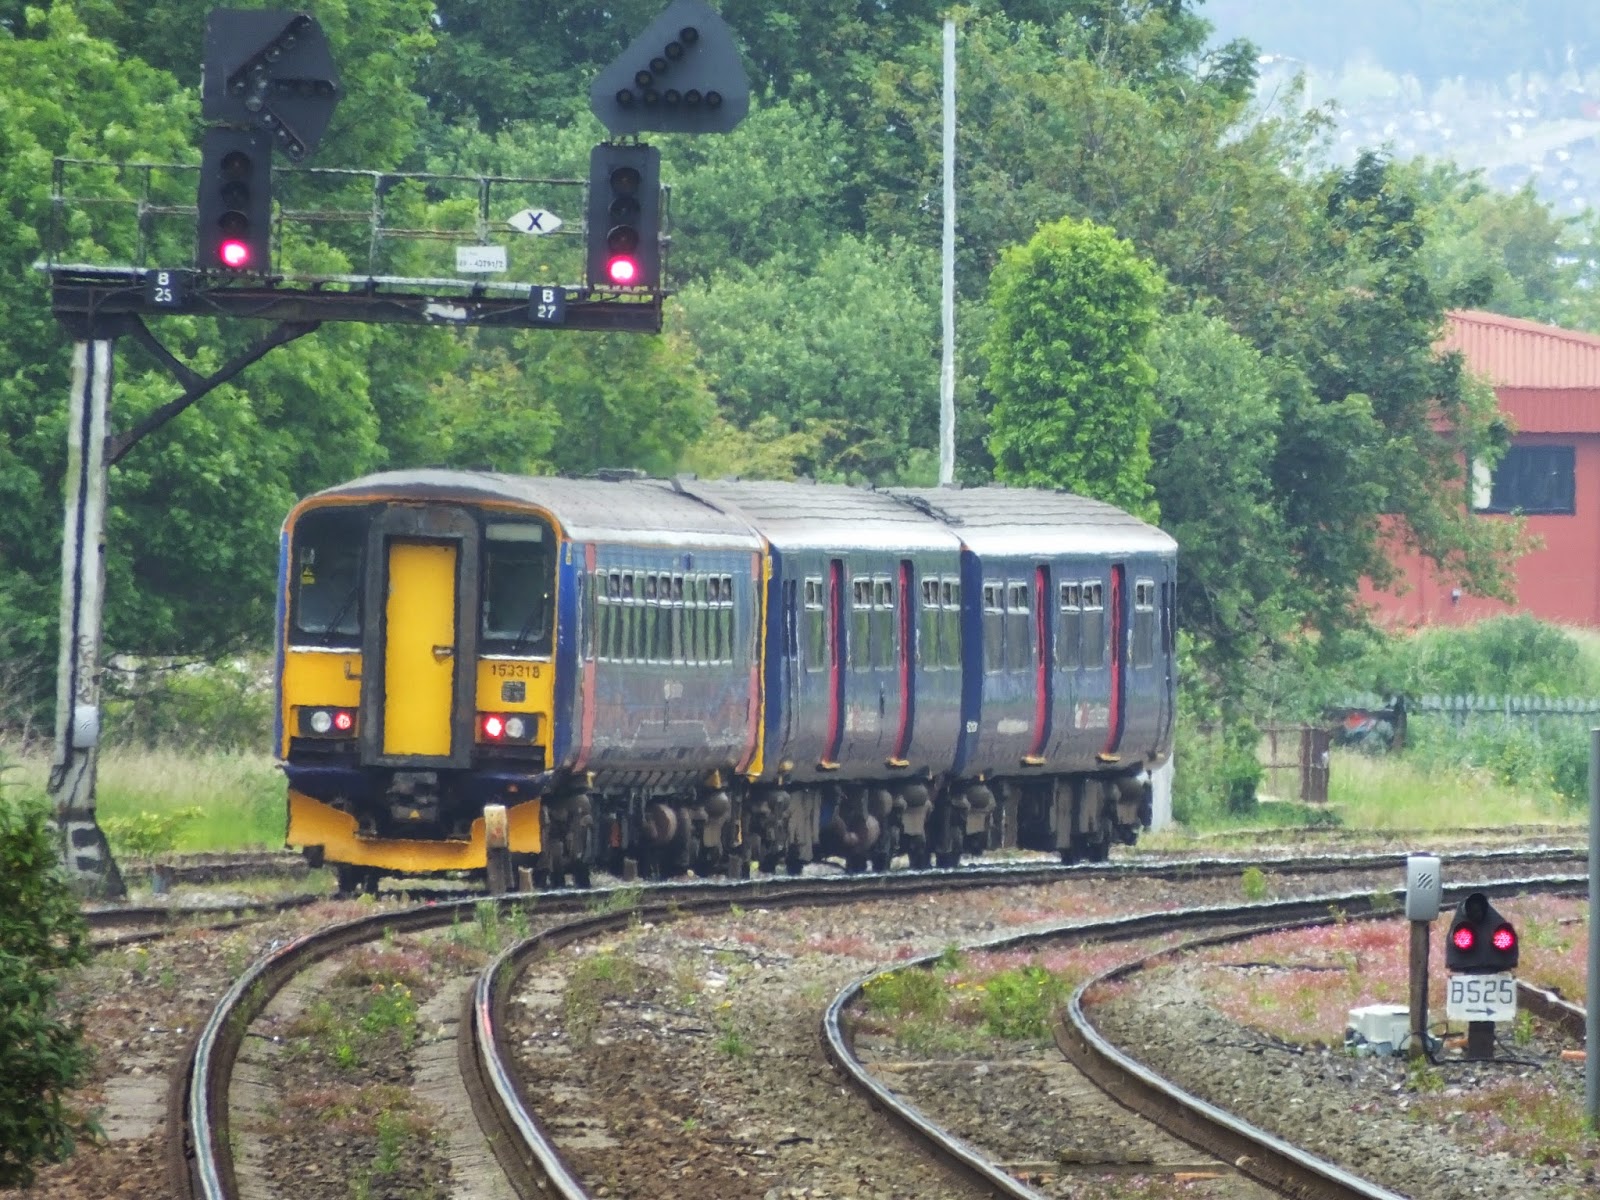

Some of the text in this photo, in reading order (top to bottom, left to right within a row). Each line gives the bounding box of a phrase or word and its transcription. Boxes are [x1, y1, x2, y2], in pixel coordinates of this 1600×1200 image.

[527, 212, 544, 232] X
[157, 271, 170, 286] B
[154, 287, 172, 302] 25
[542, 289, 554, 303] B
[537, 304, 557, 319] 27
[491, 664, 540, 679] 153318
